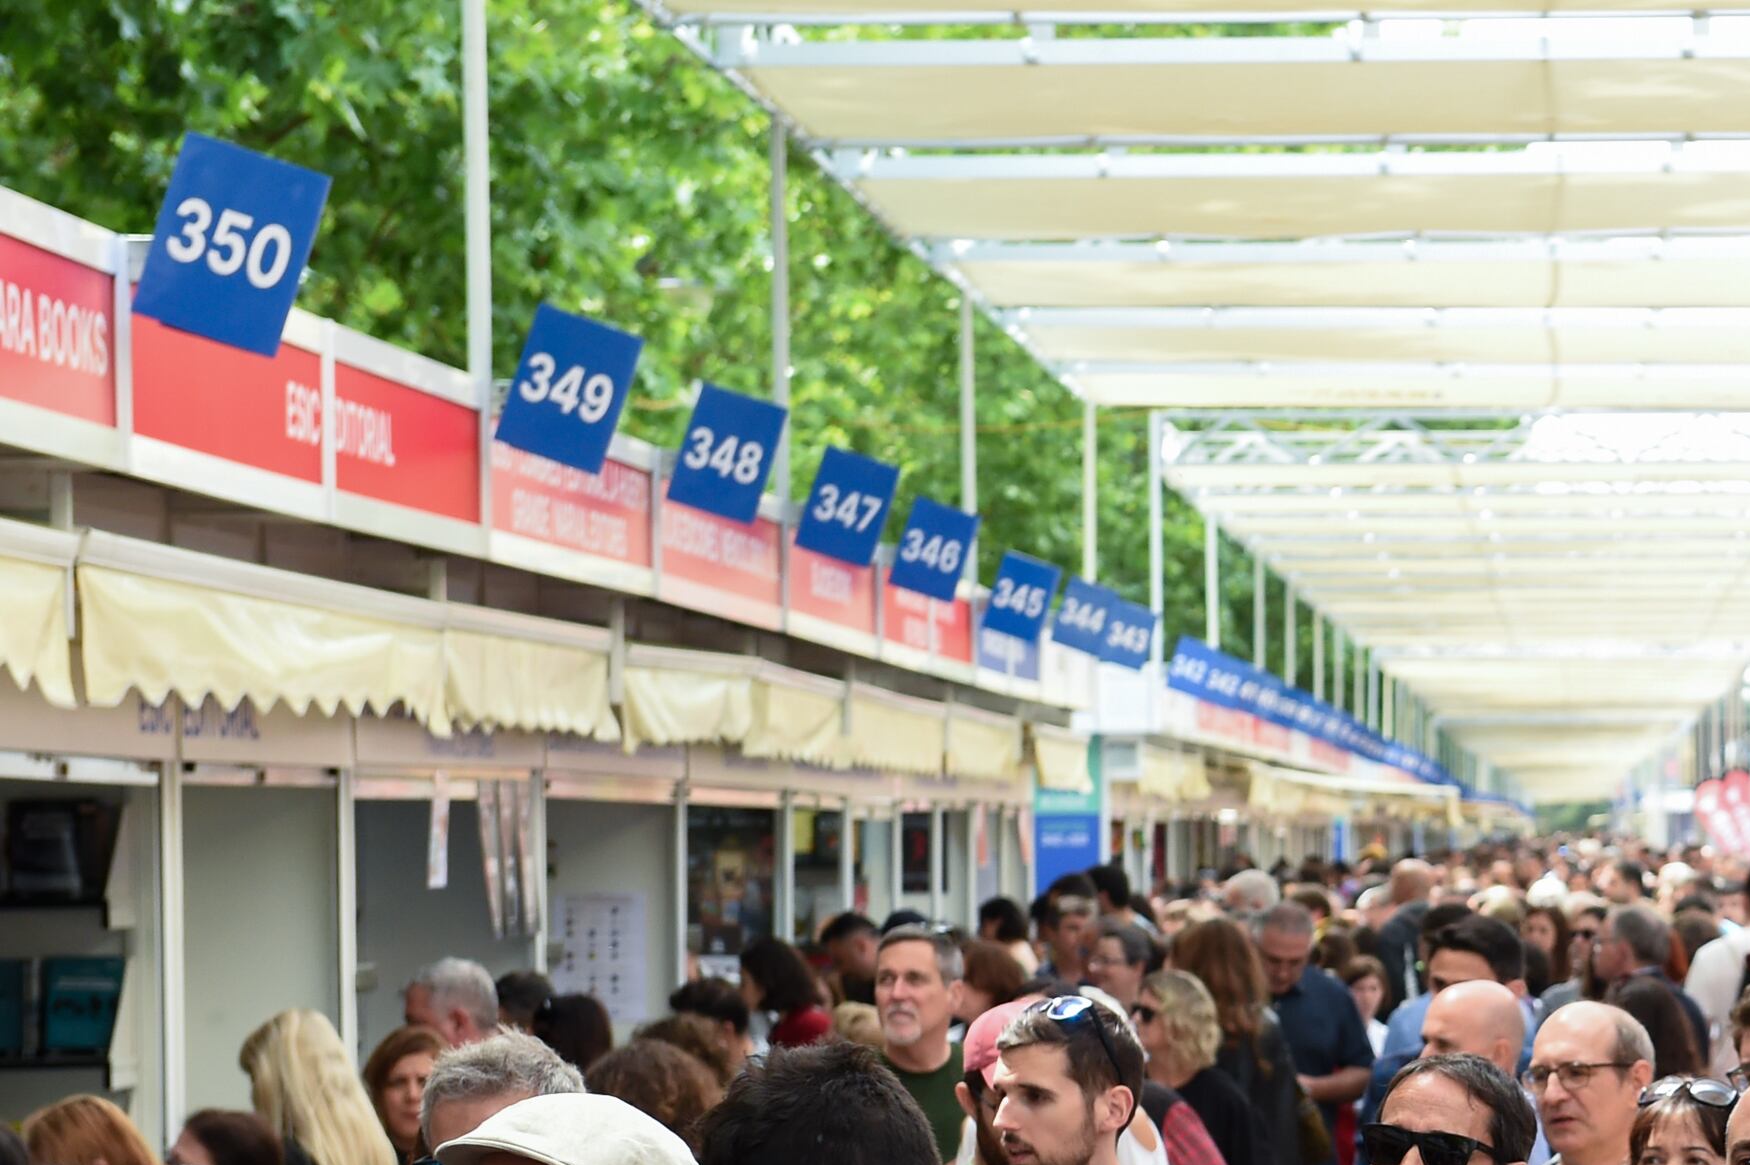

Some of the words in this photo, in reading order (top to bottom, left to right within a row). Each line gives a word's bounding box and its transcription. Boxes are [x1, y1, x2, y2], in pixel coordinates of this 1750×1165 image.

[166, 197, 292, 290] 350
[39, 292, 109, 378] BOOKS
[285, 379, 322, 446] ESIC
[519, 352, 615, 424] 349
[684, 426, 764, 484] 348
[813, 484, 884, 533] 347
[901, 528, 962, 574] 346
[992, 577, 1047, 619] 345
[1059, 597, 1107, 635] 344
[1107, 620, 1150, 655] 343
